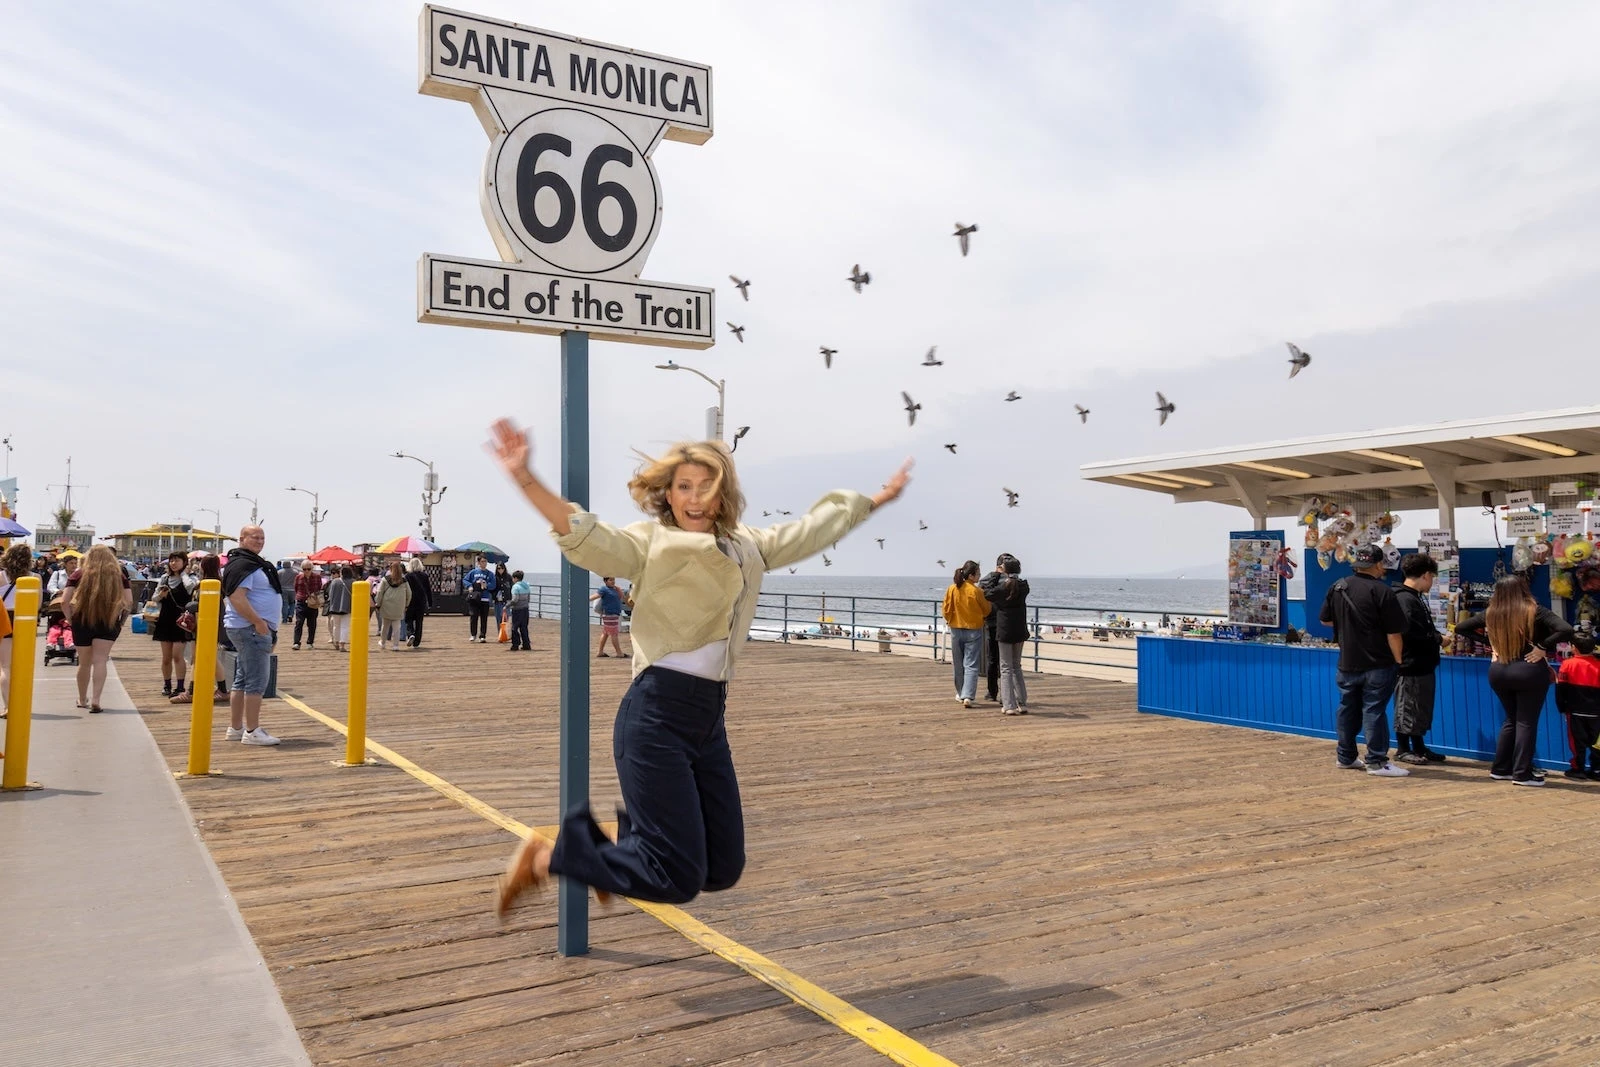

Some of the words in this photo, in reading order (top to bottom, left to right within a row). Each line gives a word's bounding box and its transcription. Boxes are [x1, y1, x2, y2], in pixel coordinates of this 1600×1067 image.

[439, 24, 555, 87] SANTA
[569, 53, 702, 116] MONICA
[516, 132, 638, 252] 66
[443, 270, 510, 311] End
[524, 280, 560, 316] of
[572, 283, 624, 322] the
[635, 293, 702, 331] Trail
